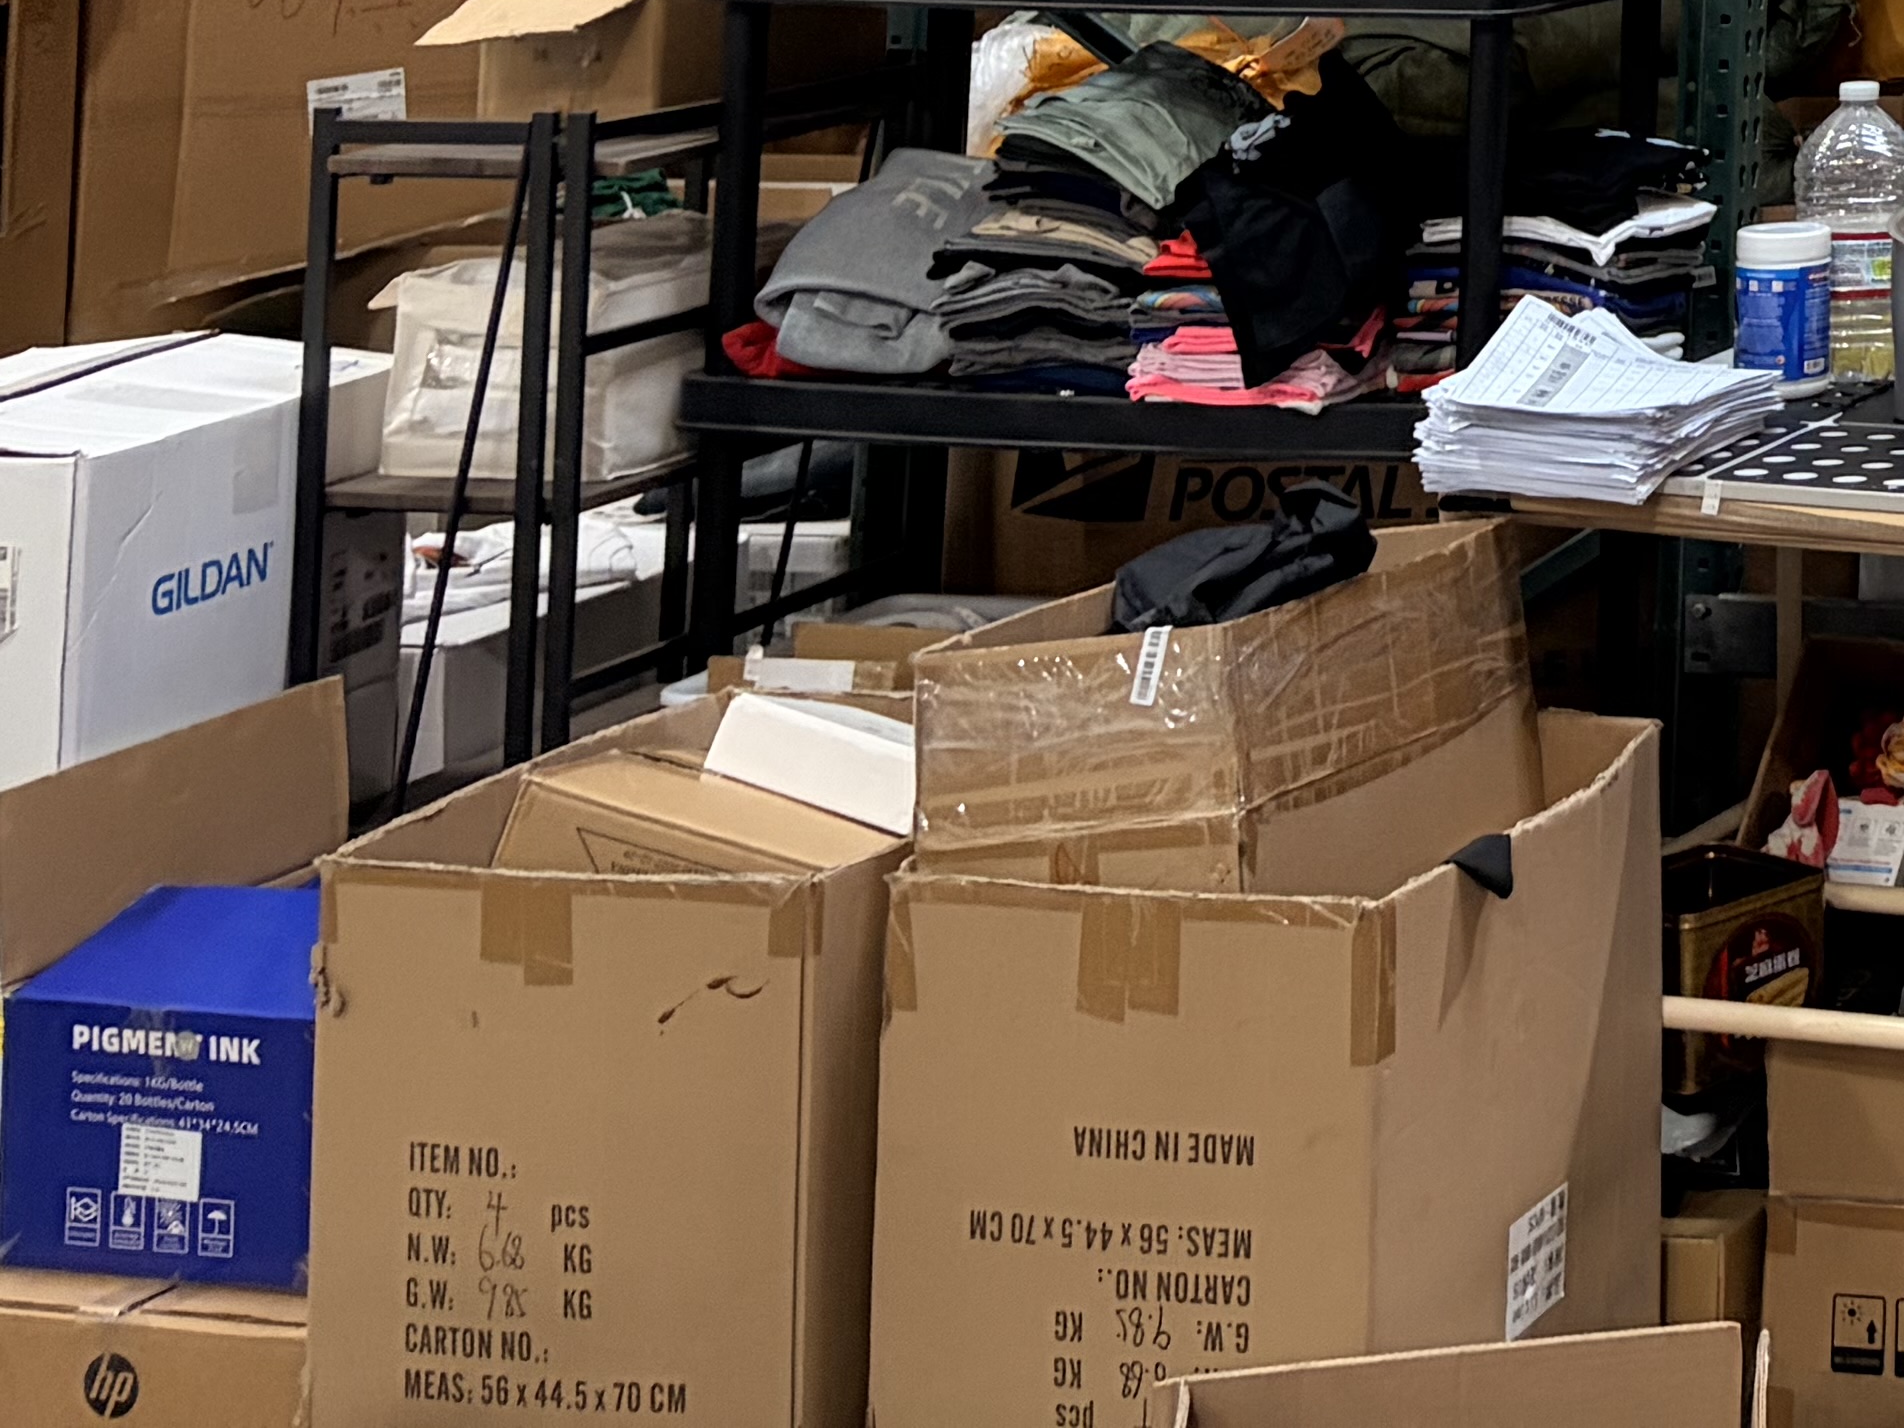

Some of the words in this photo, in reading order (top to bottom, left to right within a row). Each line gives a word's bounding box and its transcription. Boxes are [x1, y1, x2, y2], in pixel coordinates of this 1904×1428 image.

[152, 541, 274, 616] GILDAN
[72, 1023, 203, 1061] PIGMEN
[208, 1035, 261, 1065] INK
[408, 1140, 461, 1175] ITEM
[468, 1146, 518, 1180] NO.:
[1073, 1125, 1146, 1161] CHINA
[1154, 1130, 1179, 1162] IN
[1187, 1131, 1255, 1166] MADE
[407, 1186, 453, 1220] QTY:
[551, 1203, 591, 1233] pcs
[969, 1209, 1003, 1242] CM
[1011, 1212, 1037, 1246] 70
[1043, 1215, 1054, 1240] x
[1061, 1216, 1114, 1251] 44.5
[1121, 1221, 1132, 1246] x
[1139, 1222, 1169, 1256] 56
[1178, 1224, 1252, 1260] MEAS:
[407, 1232, 457, 1266] N.W:
[563, 1243, 593, 1274] KG
[405, 1276, 455, 1311] G.W:
[563, 1288, 593, 1320] KG
[1097, 1267, 1148, 1301] NO.:
[1156, 1270, 1251, 1307] CARTON
[404, 1322, 493, 1360] CARTON
[500, 1330, 549, 1364] NO.:
[1054, 1310, 1083, 1343] KG
[1196, 1319, 1250, 1354] G.W:
[85, 1352, 138, 1420] hp
[404, 1367, 474, 1405] MEAS:
[481, 1374, 509, 1407] 56
[516, 1382, 527, 1408] x
[534, 1378, 588, 1412] 44.5
[594, 1387, 606, 1413] x
[613, 1381, 641, 1413] 70
[649, 1382, 687, 1414] CM
[1053, 1357, 1082, 1390] KG
